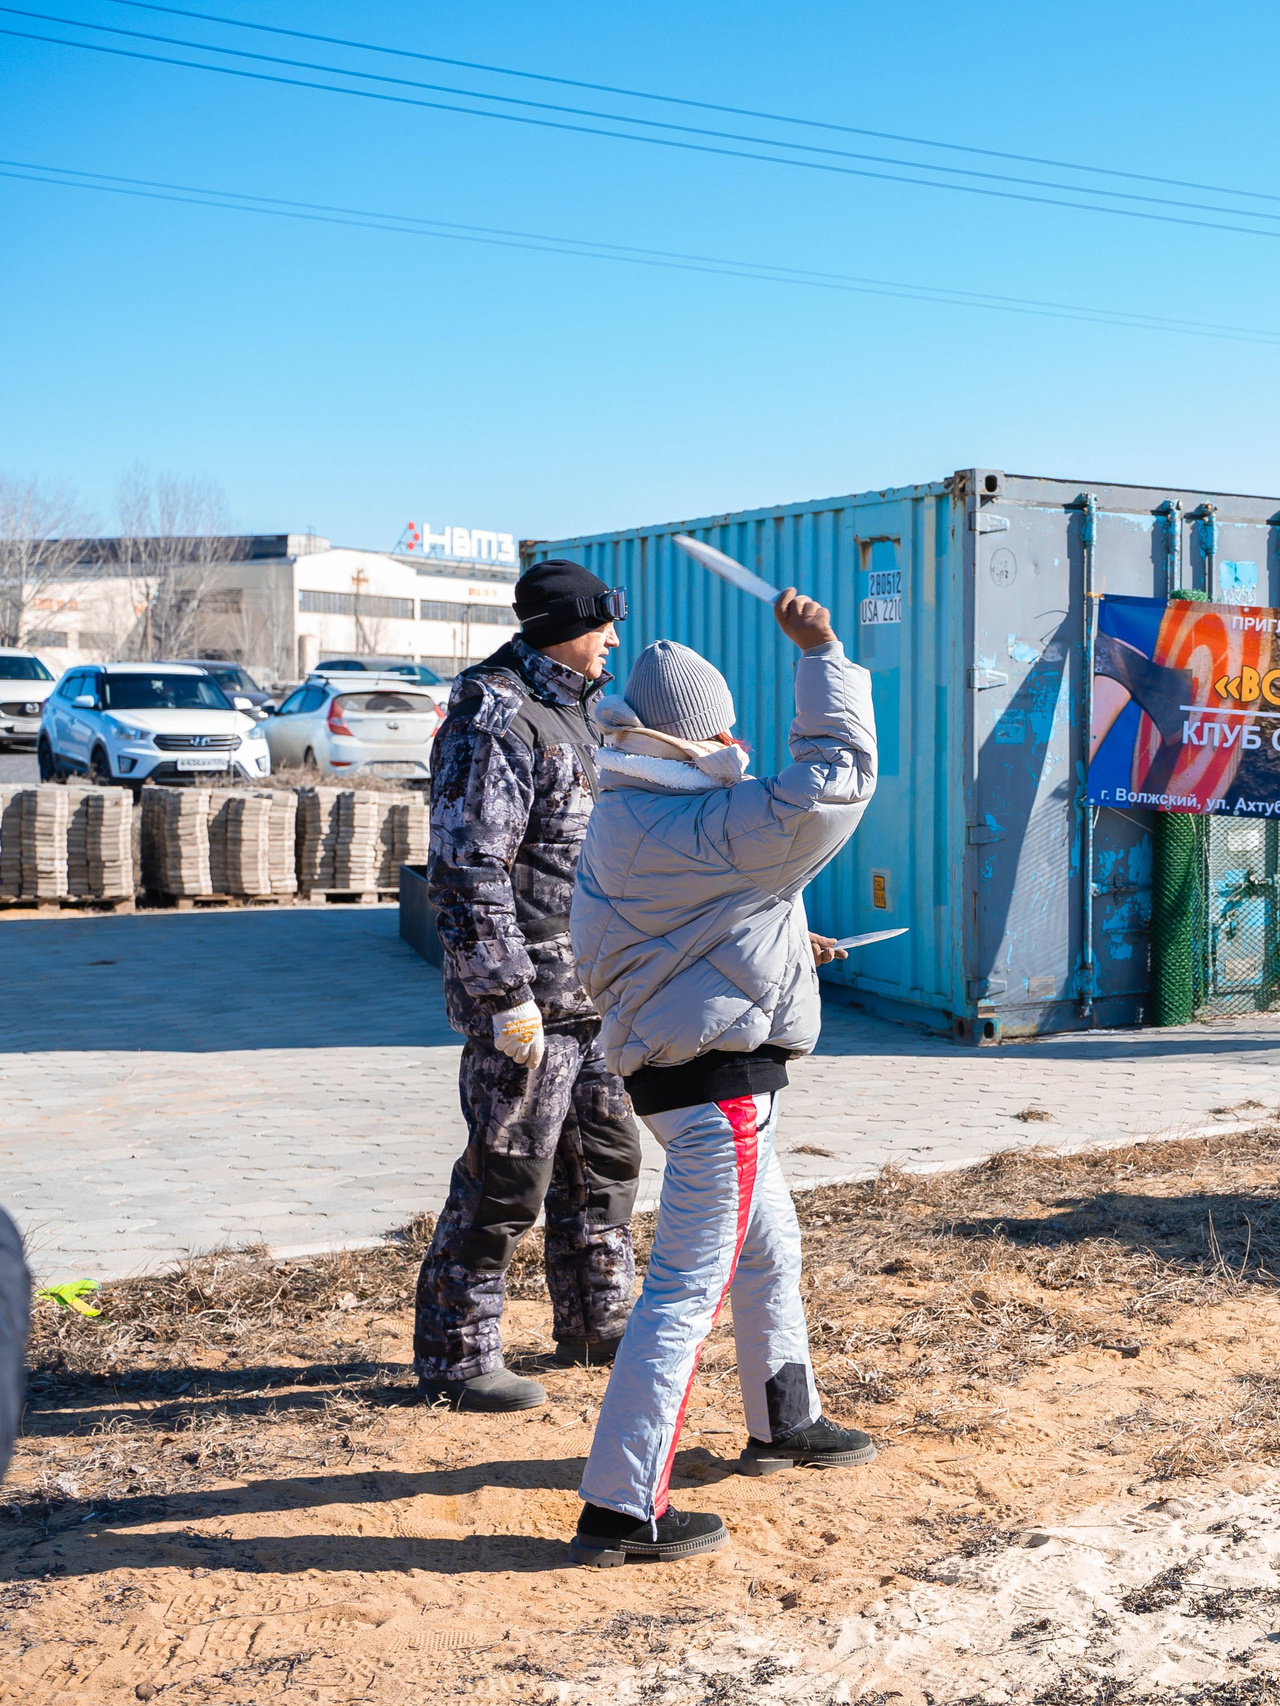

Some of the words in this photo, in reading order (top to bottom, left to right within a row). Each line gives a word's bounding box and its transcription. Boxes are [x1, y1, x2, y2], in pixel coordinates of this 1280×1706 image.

[870, 572, 901, 596] 280512
[861, 600, 878, 623] USA
[1182, 721, 1262, 750] КЛУБ
[1100, 789, 1110, 801] г.
[1115, 787, 1202, 810] Волжский,
[1206, 798, 1231, 813] ул.
